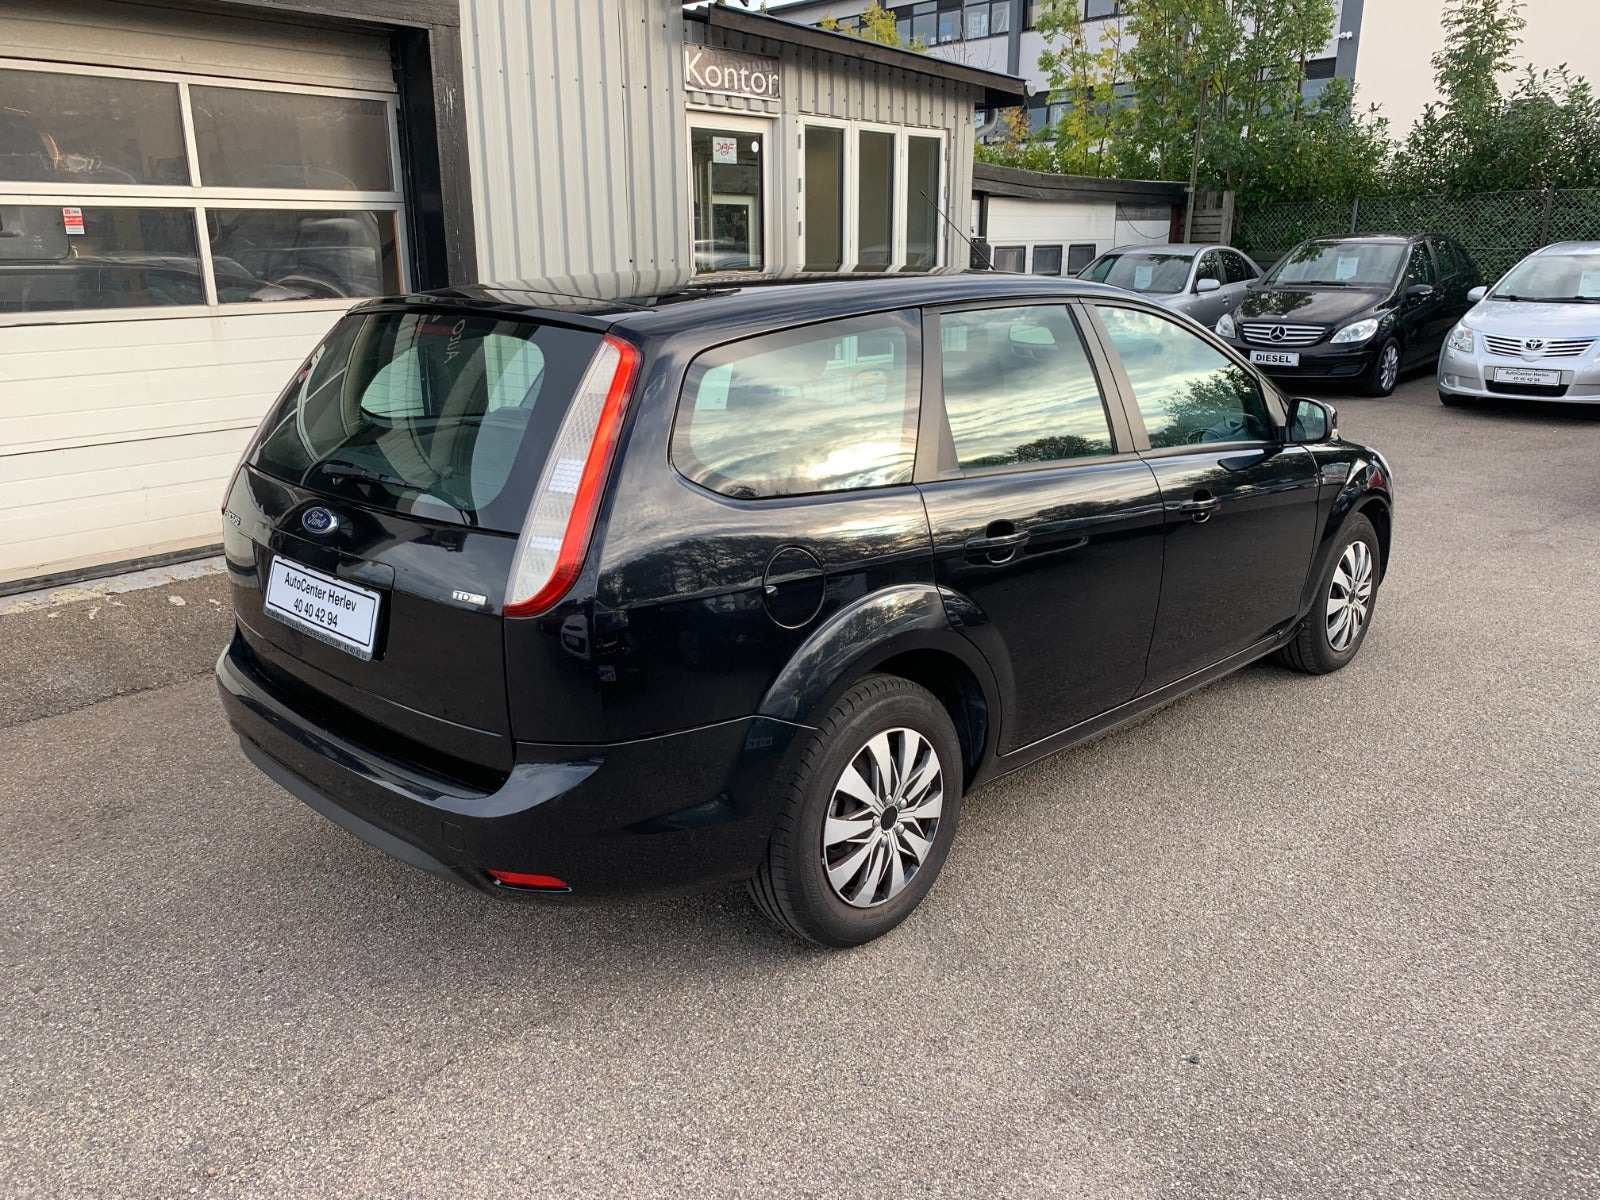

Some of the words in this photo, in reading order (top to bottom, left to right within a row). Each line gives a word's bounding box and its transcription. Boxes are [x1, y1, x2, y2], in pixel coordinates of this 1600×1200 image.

[685, 51, 779, 95] Kontor
[1256, 353, 1291, 363] DIESEL
[308, 510, 327, 528] Ford
[284, 572, 326, 600] AutoCenter
[328, 589, 357, 612] Herlev
[294, 598, 303, 613] 40
[304, 602, 314, 617] 40
[315, 607, 325, 623] 42
[328, 611, 338, 628] 94
